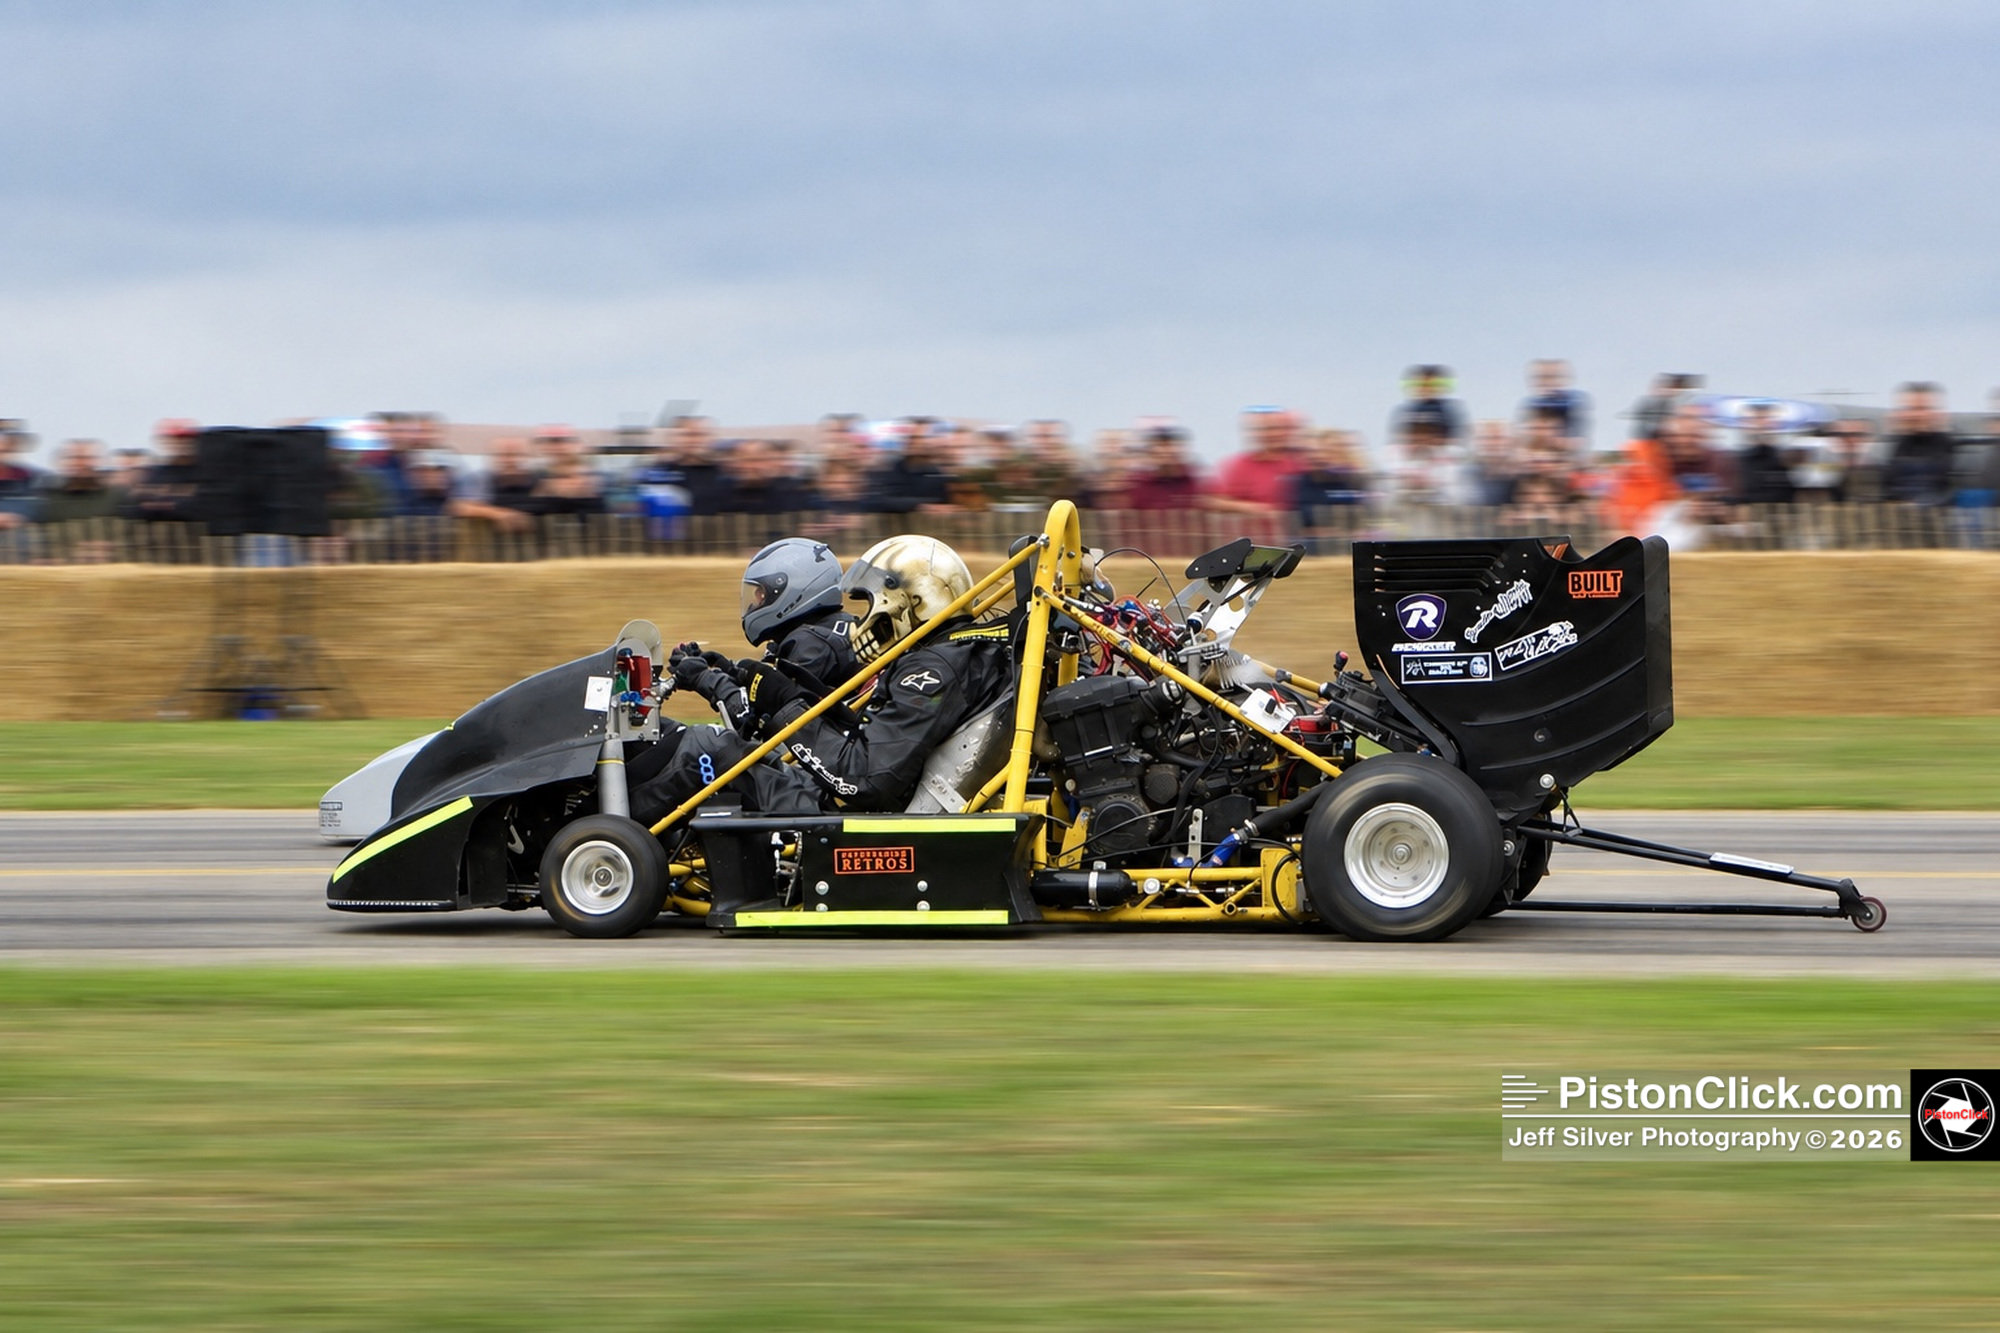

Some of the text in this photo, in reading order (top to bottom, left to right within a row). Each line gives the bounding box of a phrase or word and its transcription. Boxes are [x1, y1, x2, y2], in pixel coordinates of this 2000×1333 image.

[1570, 572, 1621, 592] BUILT
[1401, 601, 1438, 628] R
[842, 858, 907, 870] RETROS
